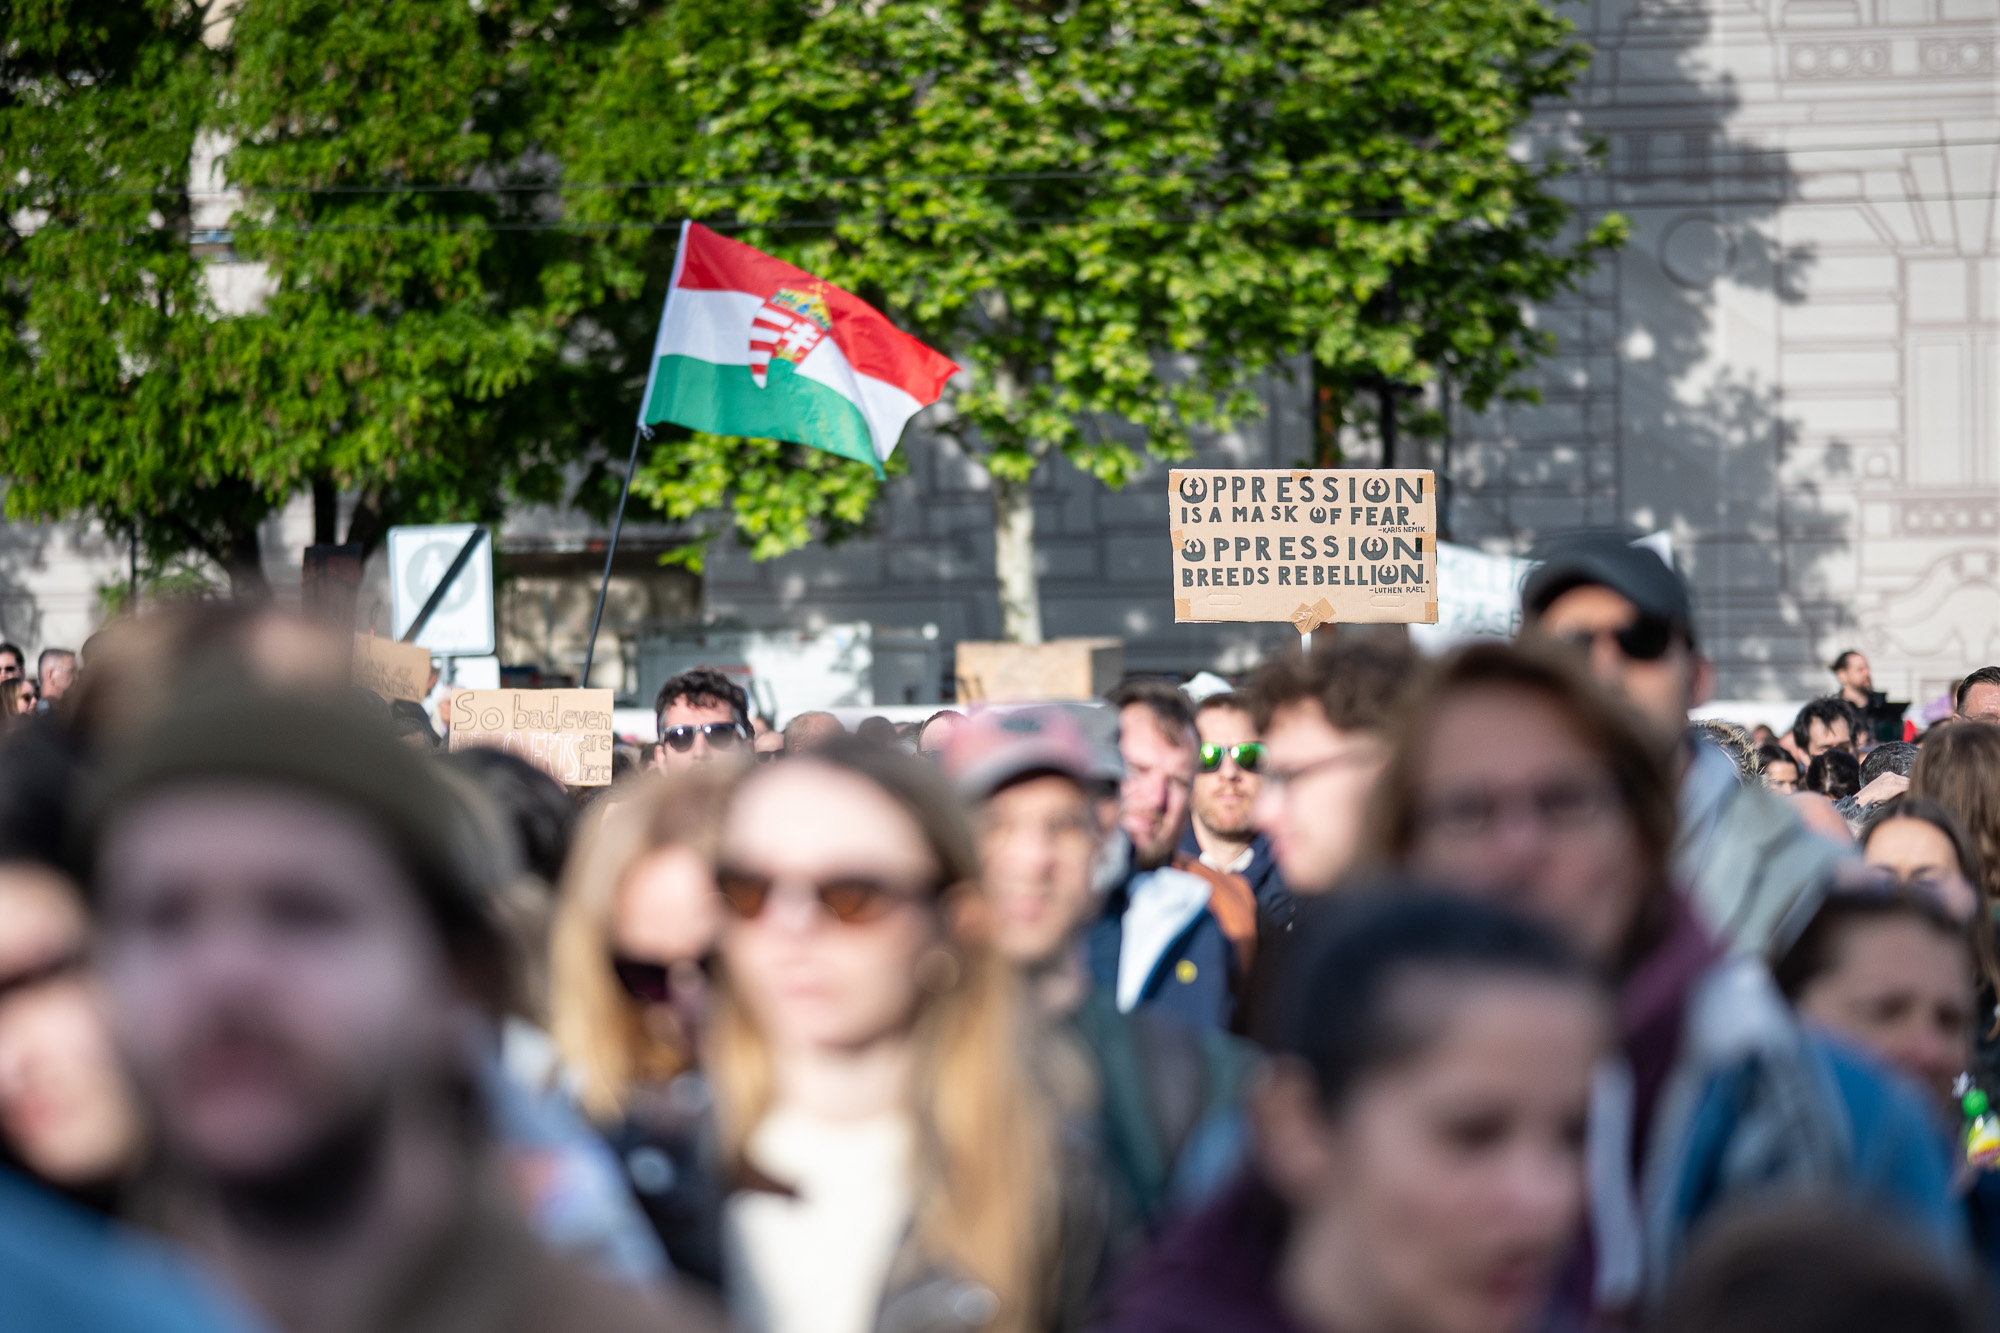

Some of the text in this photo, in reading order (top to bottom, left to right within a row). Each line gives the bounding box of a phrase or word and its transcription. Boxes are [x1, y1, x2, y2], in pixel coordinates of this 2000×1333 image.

[1180, 477, 1424, 503] OPPRESSION
[1182, 506, 1416, 526] IS A MASK OF FEAR.
[1182, 536, 1423, 562] OPPRESSION
[1182, 567, 1270, 587] BREEDS
[1278, 564, 1430, 586] REBELLION.
[454, 692, 504, 730] So
[579, 734, 611, 752] are
[579, 753, 611, 782] here
